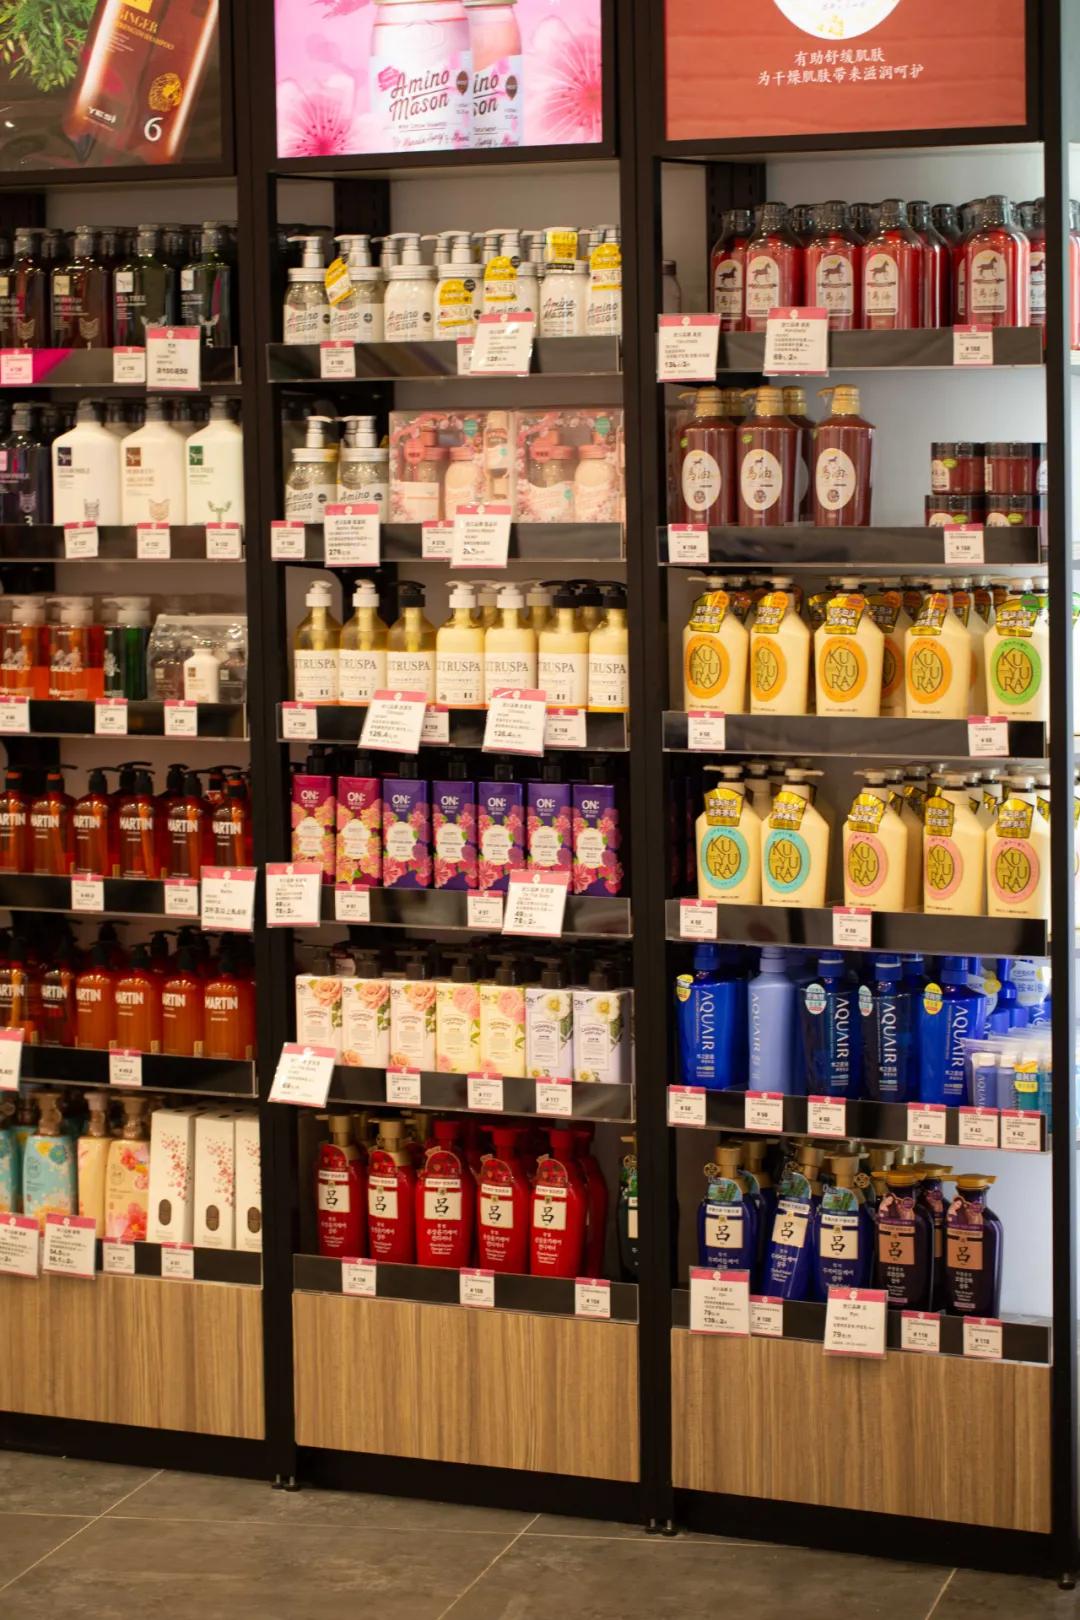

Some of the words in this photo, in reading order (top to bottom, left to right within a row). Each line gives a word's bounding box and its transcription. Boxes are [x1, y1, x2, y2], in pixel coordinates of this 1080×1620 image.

[794, 48, 886, 67] 有助舒缓肌肤
[391, 69, 449, 98] Amino
[758, 64, 925, 86] 为干燥肌肤带来滋润呵护
[389, 92, 449, 122] Mason
[144, 117, 164, 141] 6
[204, 996, 238, 1010] MARTIN
[700, 990, 716, 1050] AQUAIR
[834, 997, 850, 1059] AQUAIR
[880, 1002, 898, 1063] AQUAIR
[952, 1005, 970, 1068] AQUAIR
